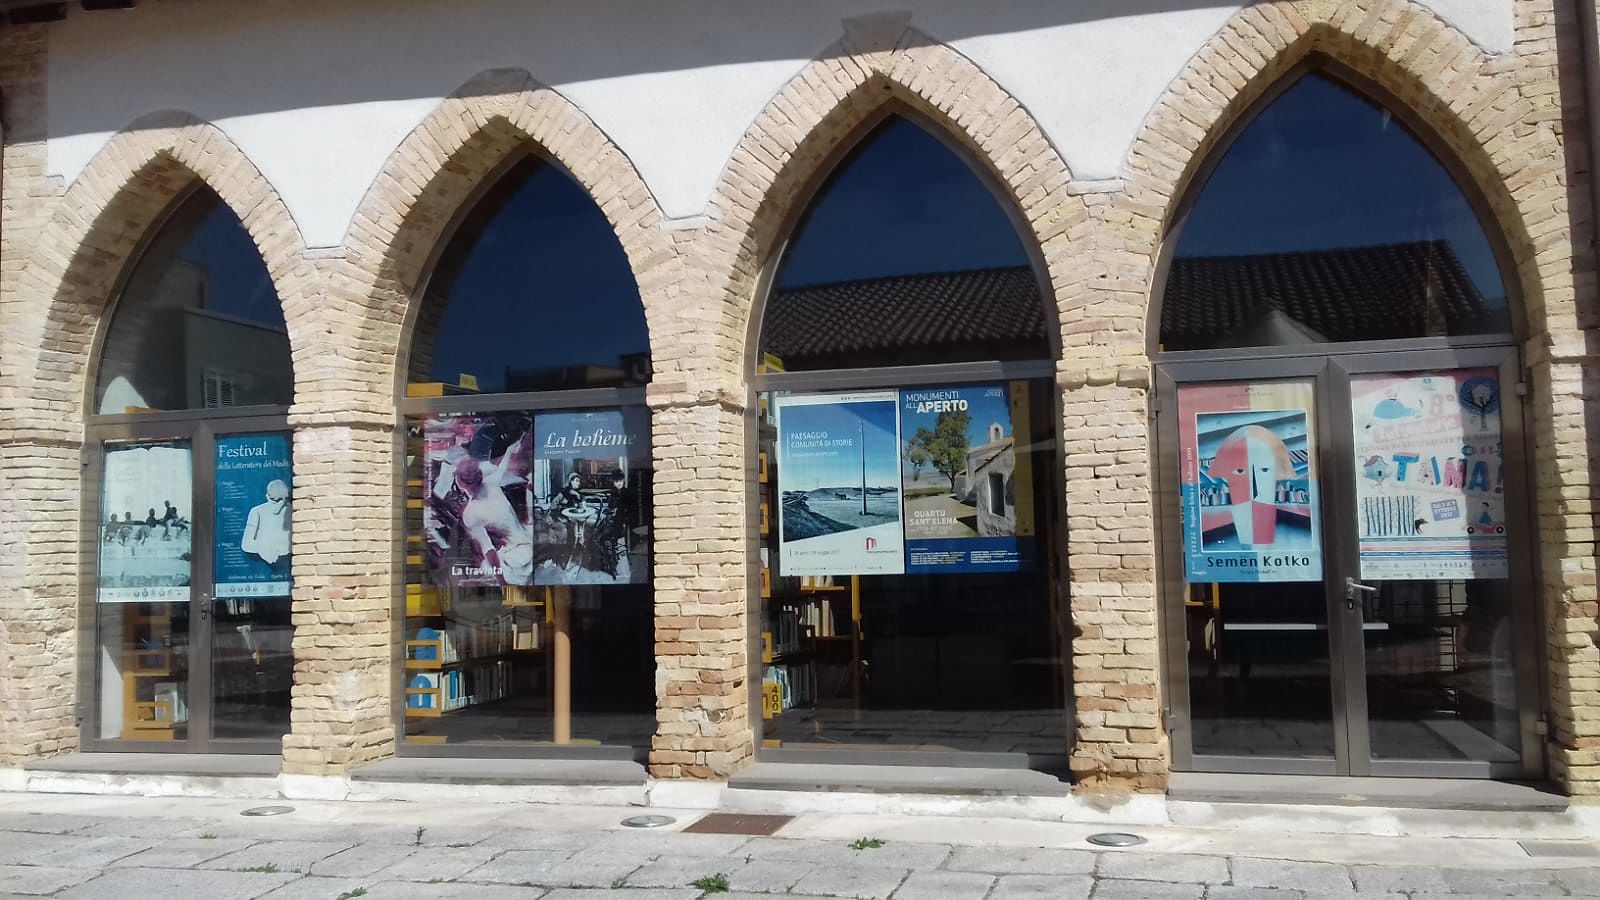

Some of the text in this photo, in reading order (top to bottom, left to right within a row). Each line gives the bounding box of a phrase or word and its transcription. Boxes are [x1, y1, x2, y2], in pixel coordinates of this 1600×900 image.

[905, 391, 960, 403] MONUMENTI
[916, 399, 969, 414] APERTO
[543, 427, 637, 448] La bohème
[790, 431, 828, 440] PAESAGGIO
[831, 438, 853, 447] STORIE
[217, 440, 268, 458] Festival
[914, 509, 946, 518] QUARTU
[1206, 555, 1310, 567] Semën Kotko
[451, 566, 503, 576] La traviata
[771, 686, 779, 711] 400
